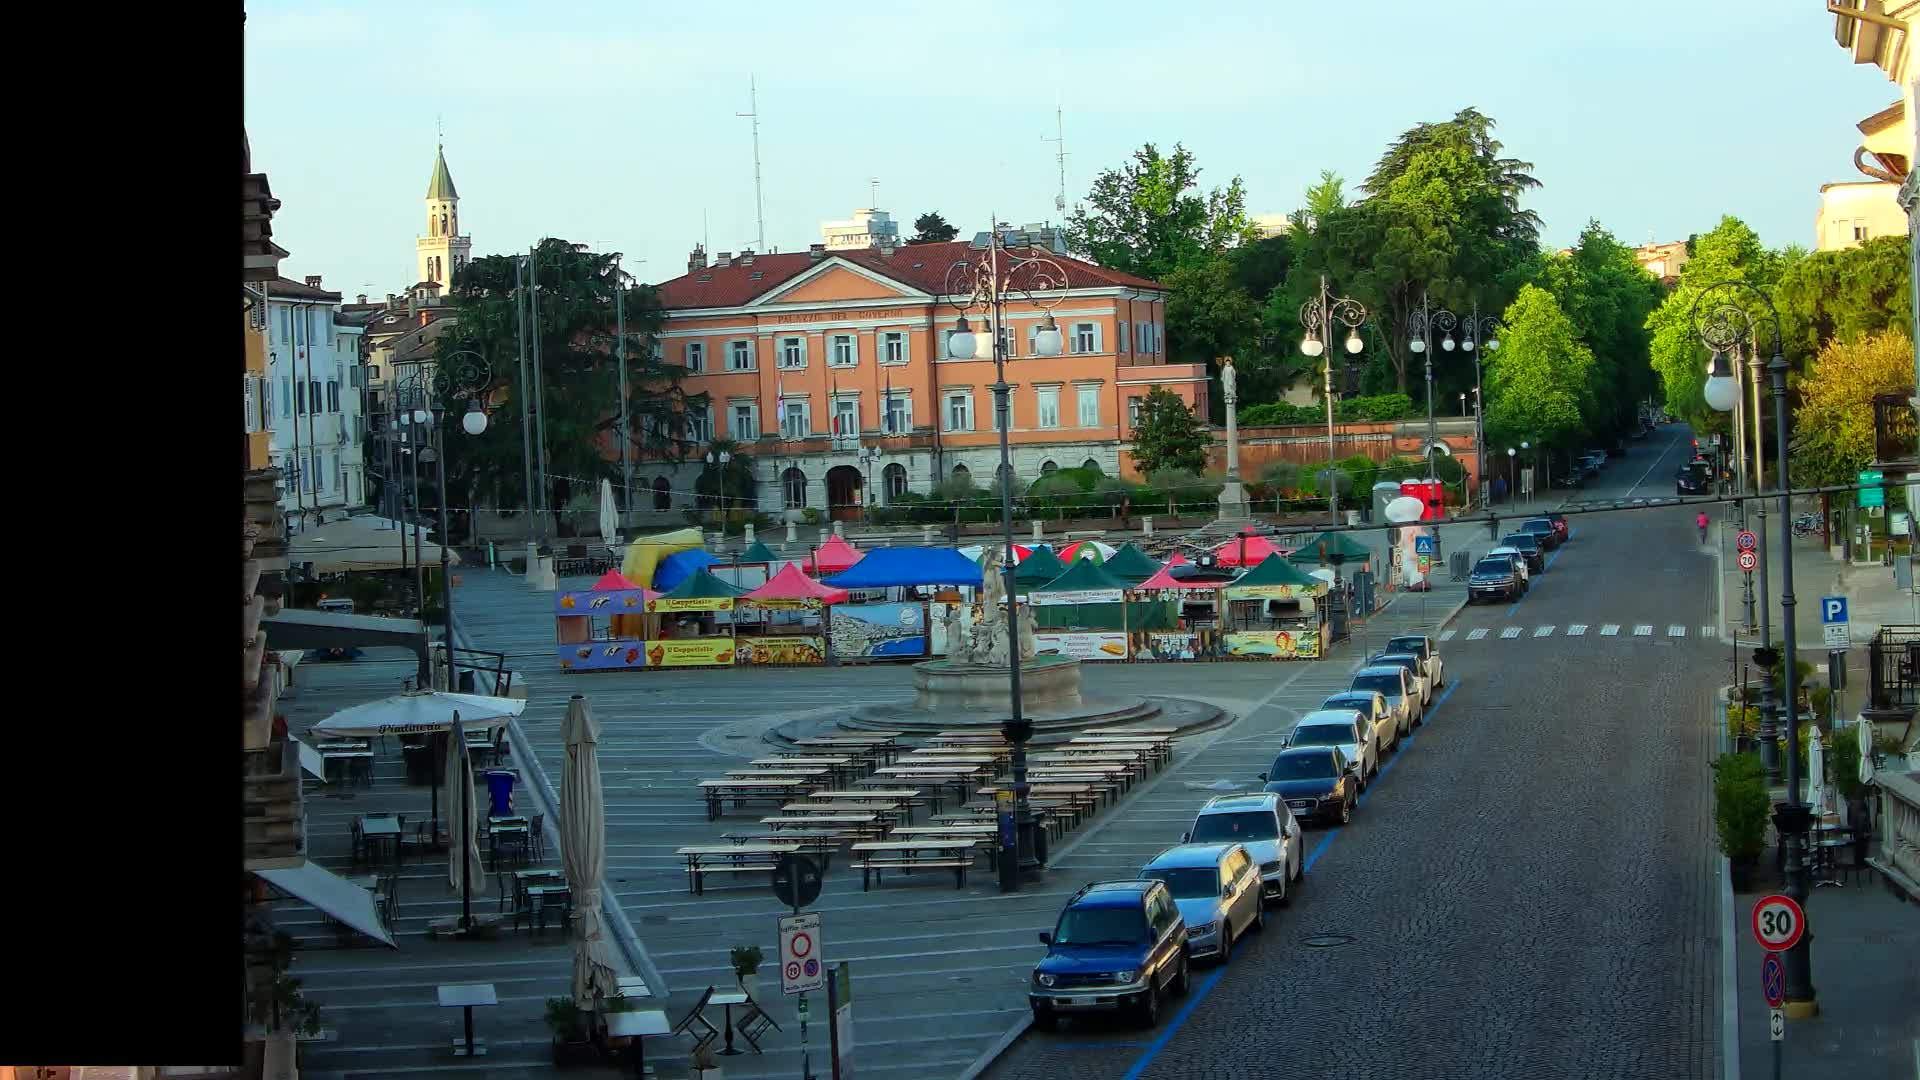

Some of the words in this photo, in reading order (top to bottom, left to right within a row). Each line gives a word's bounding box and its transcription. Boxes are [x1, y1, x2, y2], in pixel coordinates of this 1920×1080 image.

[1742, 556, 1752, 565] 20
[1827, 600, 1842, 620] P
[1763, 910, 1791, 936] 30
